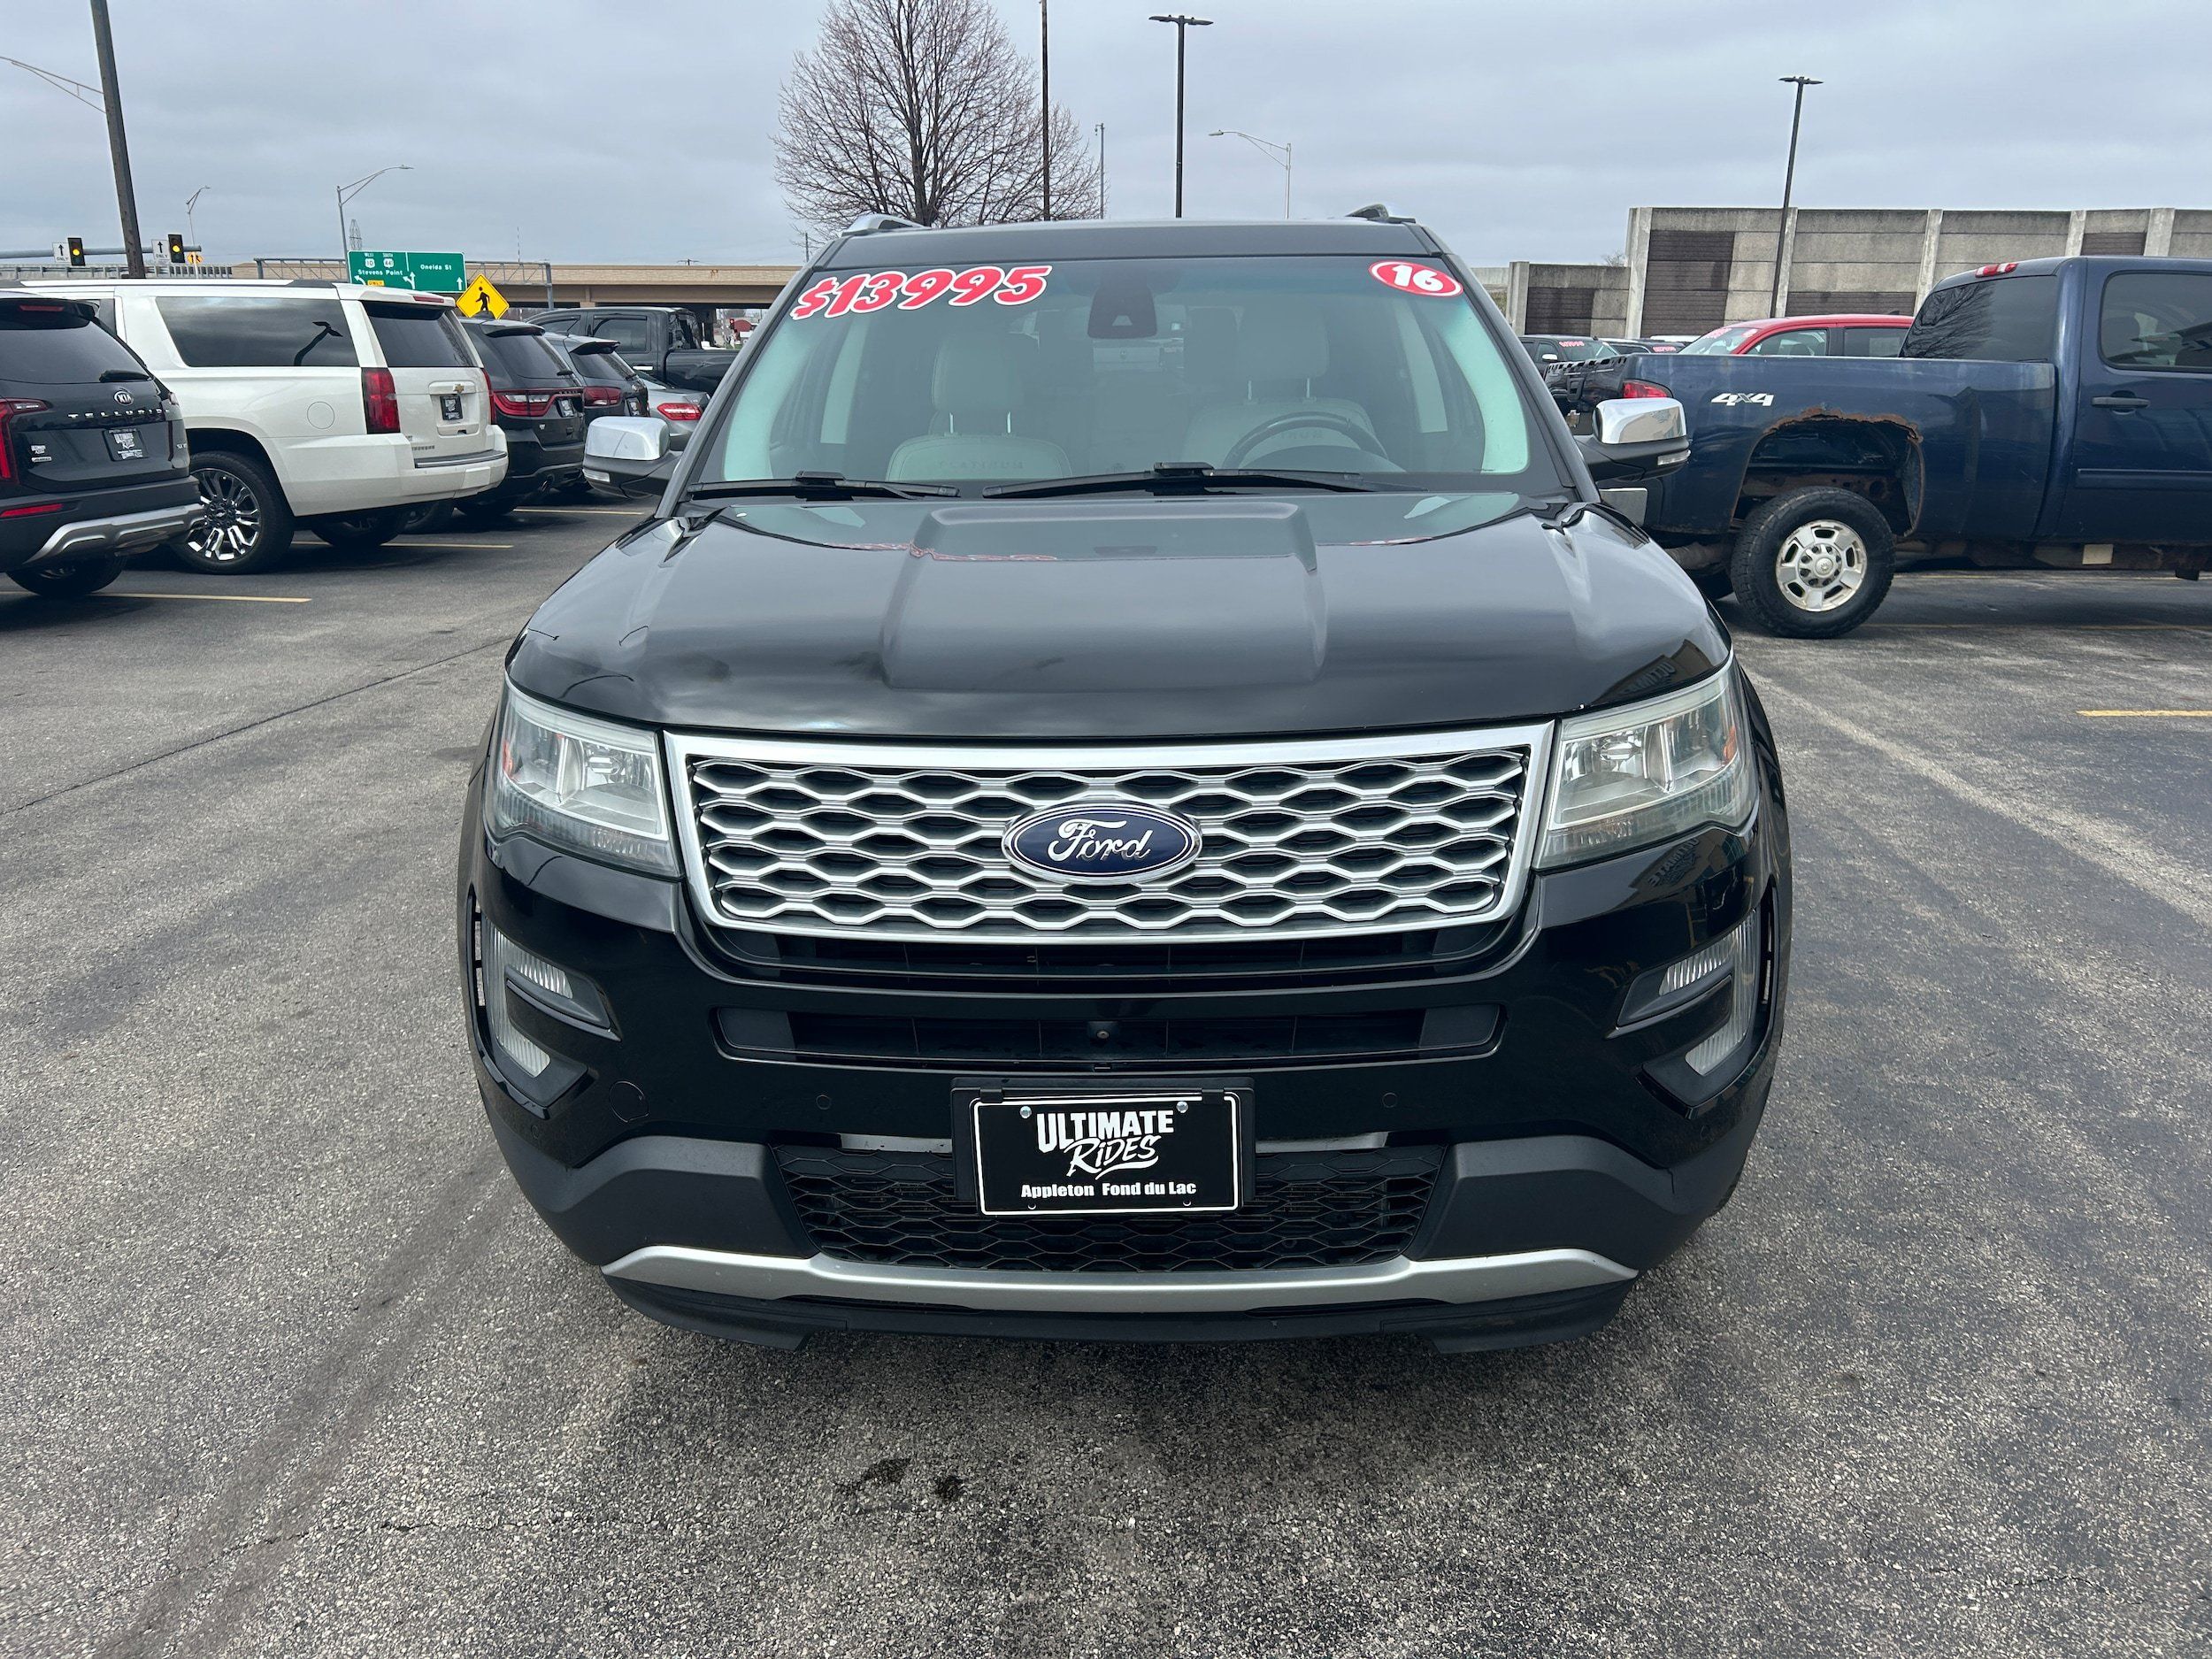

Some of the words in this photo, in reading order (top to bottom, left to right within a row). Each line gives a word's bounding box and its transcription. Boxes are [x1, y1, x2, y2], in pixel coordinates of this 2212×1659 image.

[790, 265, 1052, 319] $13995
[1392, 265, 1443, 291] 16
[117, 392, 132, 403] KIA
[1048, 818, 1154, 862] Ford
[1037, 1110, 1175, 1154] ULTIMATE
[1021, 1184, 1094, 1199] Appleton
[1102, 1182, 1141, 1196] Fond
[1144, 1182, 1165, 1195] du
[1169, 1182, 1197, 1194] Lac
